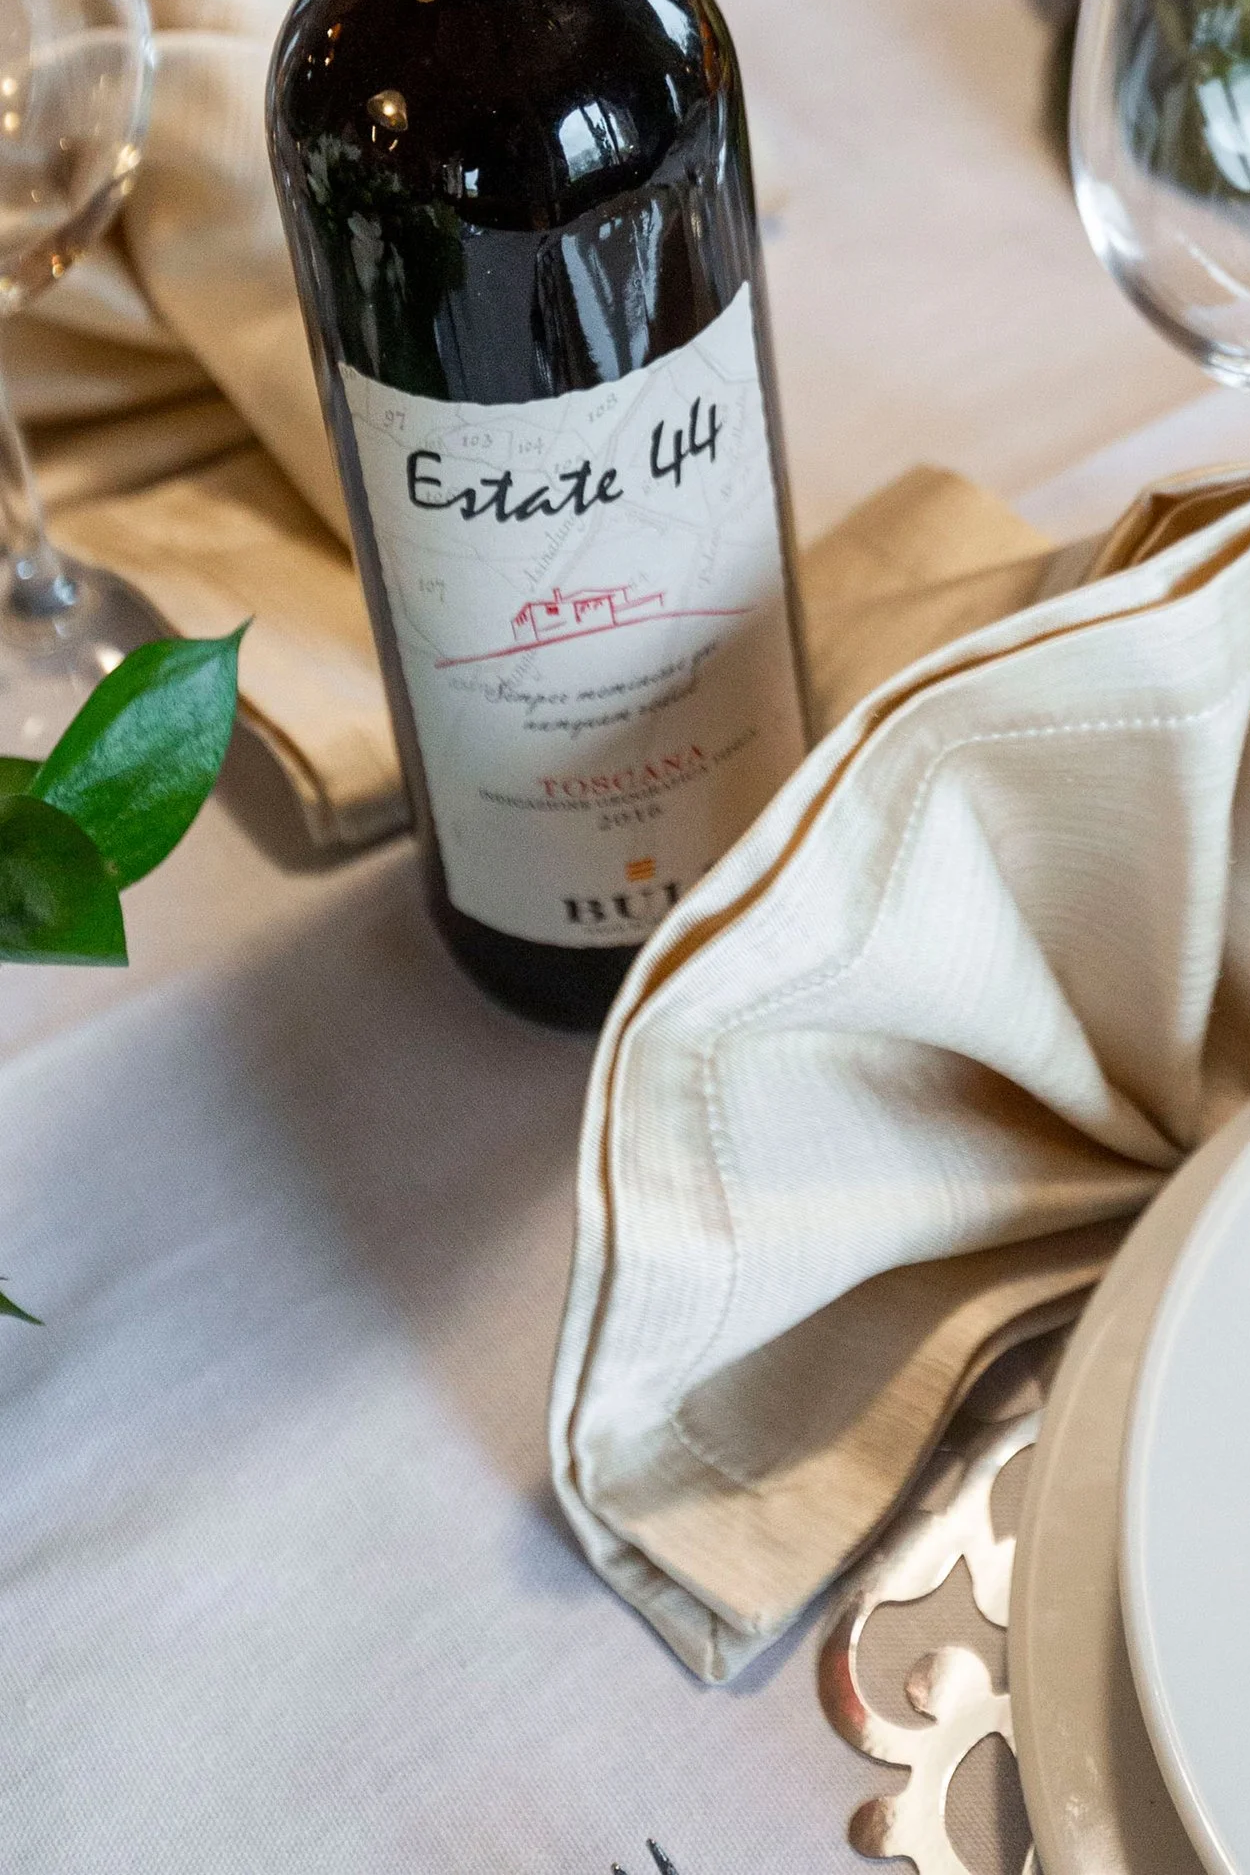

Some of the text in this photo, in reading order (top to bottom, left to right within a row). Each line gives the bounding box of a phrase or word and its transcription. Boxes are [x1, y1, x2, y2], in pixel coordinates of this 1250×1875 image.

[406, 449, 624, 523] Estate
[649, 396, 722, 487] 44
[461, 433, 494, 449] 103
[538, 744, 705, 798] TOSCANA
